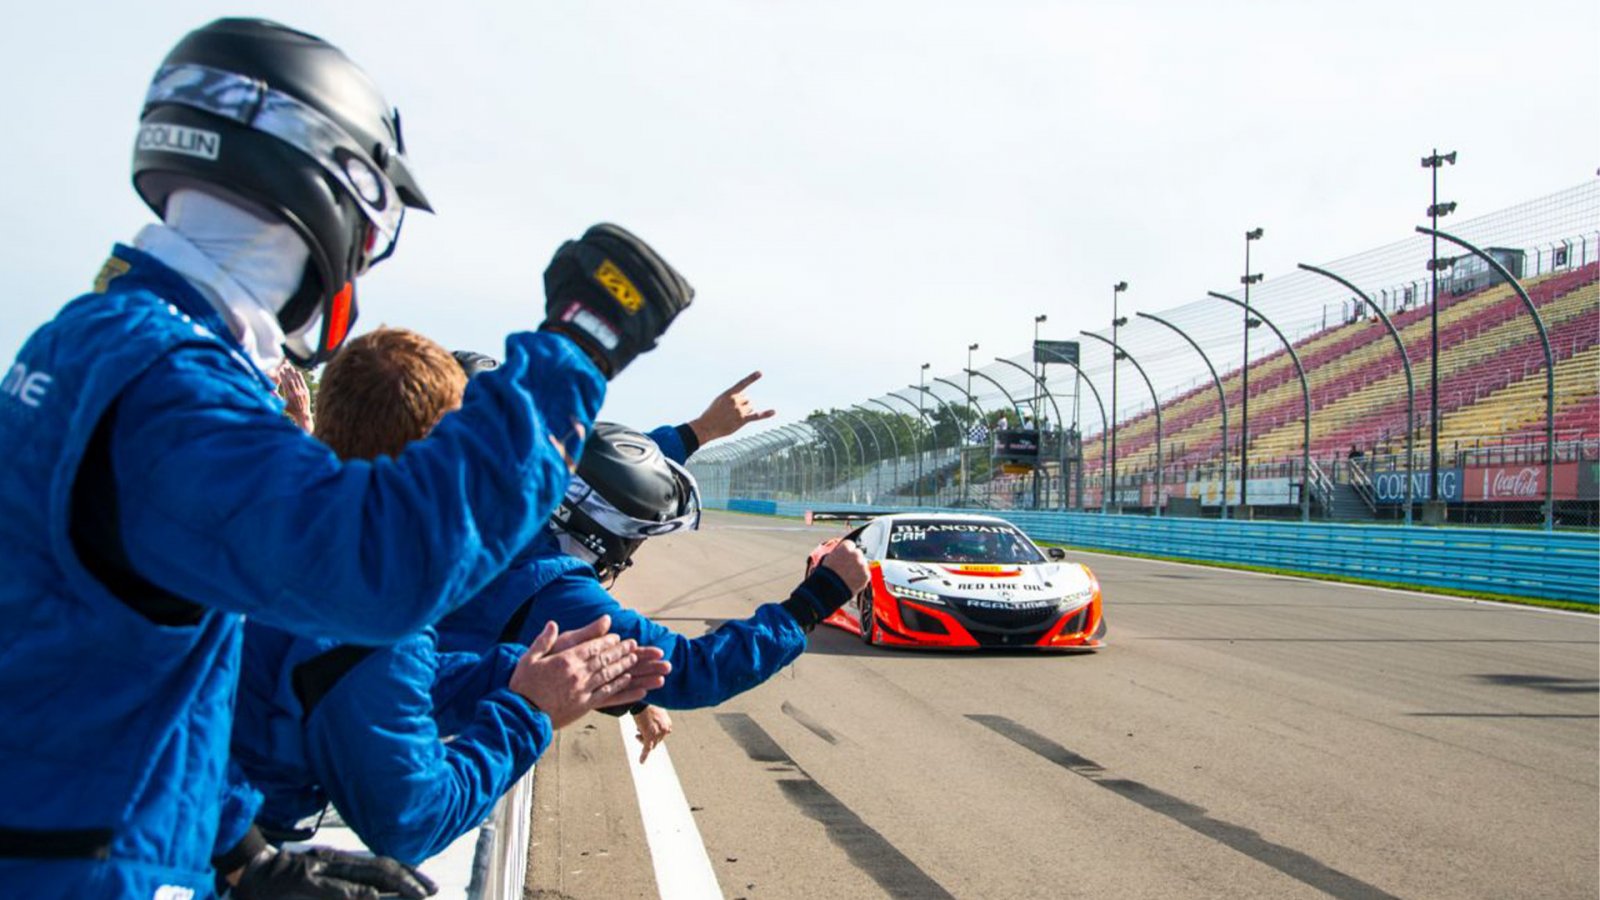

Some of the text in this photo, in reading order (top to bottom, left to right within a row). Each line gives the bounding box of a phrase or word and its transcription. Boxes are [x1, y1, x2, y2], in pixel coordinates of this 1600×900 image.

[140, 126, 217, 156] COLLIN
[1493, 468, 1541, 497] Coca-Cola
[896, 524, 1016, 535] BLANCPAIN
